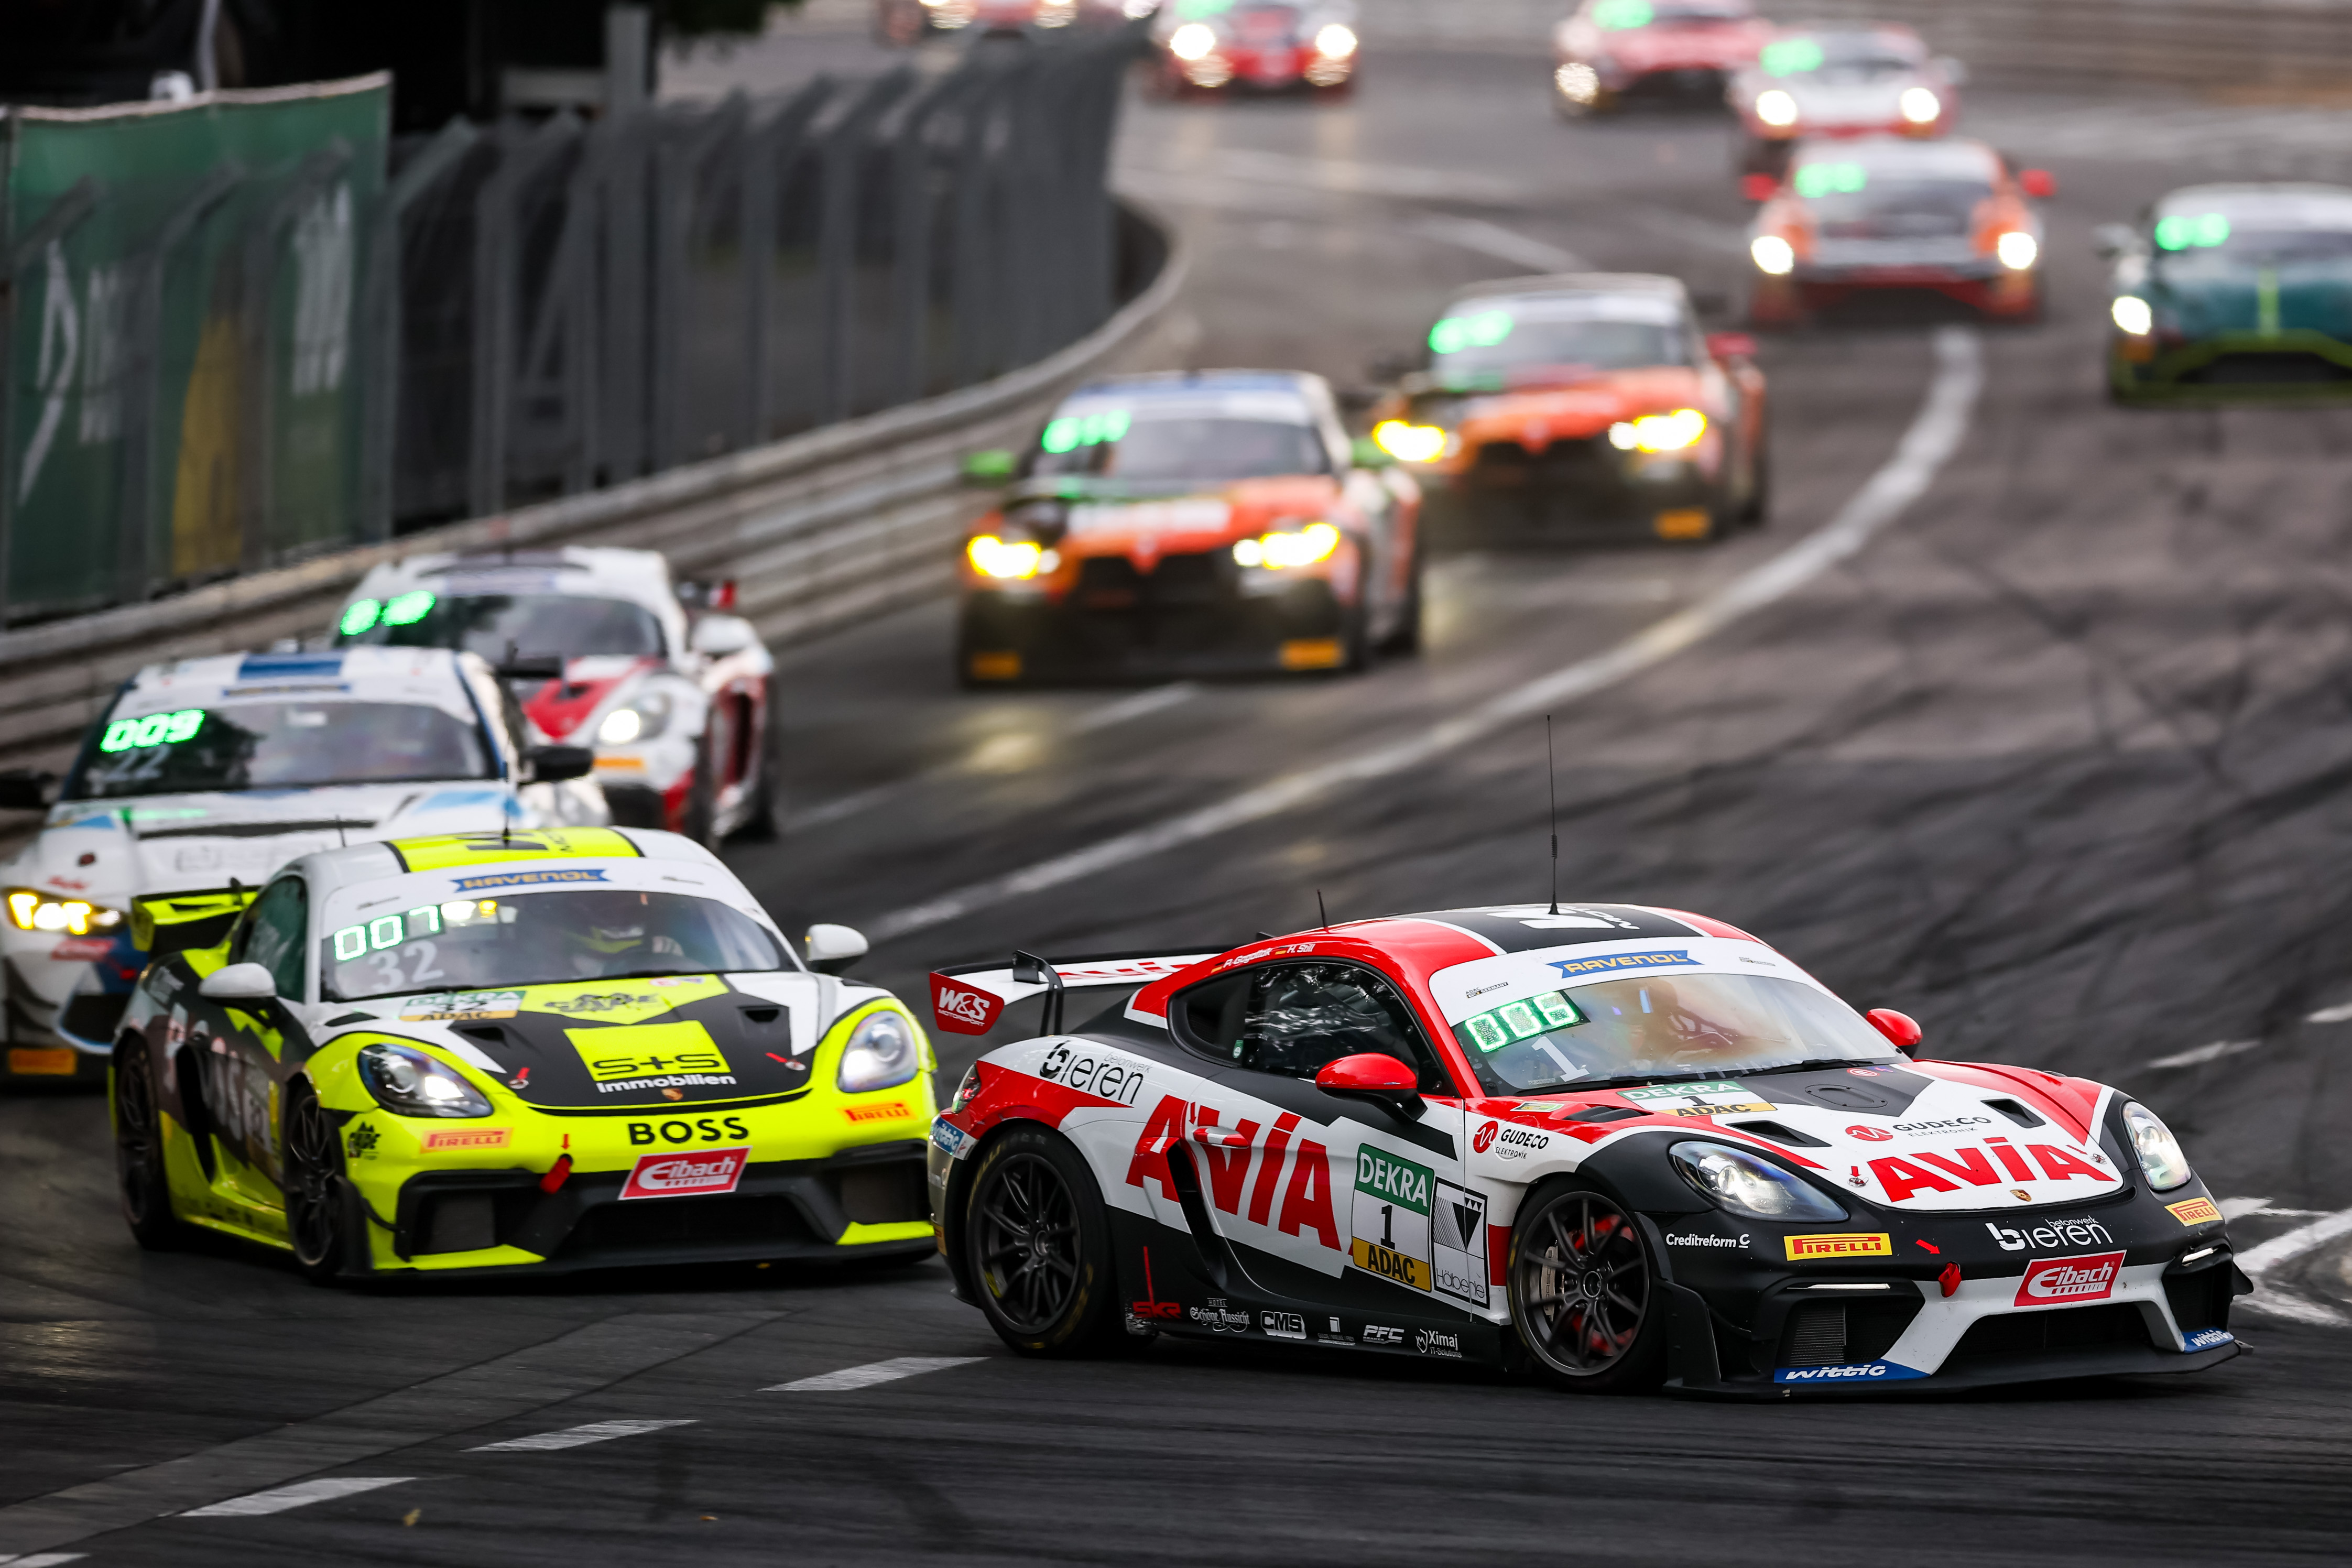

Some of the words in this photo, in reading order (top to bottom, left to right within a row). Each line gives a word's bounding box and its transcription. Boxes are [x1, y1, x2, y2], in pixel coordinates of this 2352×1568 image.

[100, 709, 205, 753] 009
[463, 872, 598, 889] RAVENOL
[334, 906, 440, 961] 007
[368, 940, 444, 993] 32
[1563, 954, 1688, 973] RAVENOL
[1480, 982, 1508, 994] GERMANY
[410, 992, 520, 1005] DEKRA
[939, 987, 990, 1021] W&S
[1465, 991, 1577, 1053] 006
[593, 1054, 720, 1075] S+S
[1531, 1036, 1590, 1082] 1
[1040, 1040, 1144, 1105] bieren
[596, 1074, 737, 1093] Immobilien
[1623, 1083, 1744, 1099] DEKRA
[1676, 1104, 1751, 1117] ADAC
[1681, 1095, 1715, 1107] 1
[845, 1103, 910, 1121] PIRELLI
[628, 1117, 749, 1145] BOSS
[1892, 1117, 1992, 1131] GUDECO
[1908, 1127, 1979, 1137] ELEKTRONIK
[428, 1131, 504, 1148] PIRELLI
[1501, 1129, 1549, 1150] GUDECO
[637, 1157, 737, 1190] Eibach
[1359, 1152, 1428, 1207] DEKRA
[2045, 1215, 2099, 1227] betonwerk
[2171, 1201, 2217, 1221] PIRELLI
[1380, 1204, 1395, 1250] 1
[1985, 1223, 2114, 1251] bieren
[1665, 1233, 1737, 1248] Creditreform
[1792, 1236, 1881, 1255] PIRELLI
[1367, 1244, 1415, 1284] ADAC
[2027, 1262, 2113, 1298] Eibach
[1260, 1310, 1306, 1340] CMS
[1363, 1325, 1405, 1341] PFC
[1428, 1330, 1458, 1351] Ximaj
[1430, 1347, 1462, 1358] IT-Solutions
